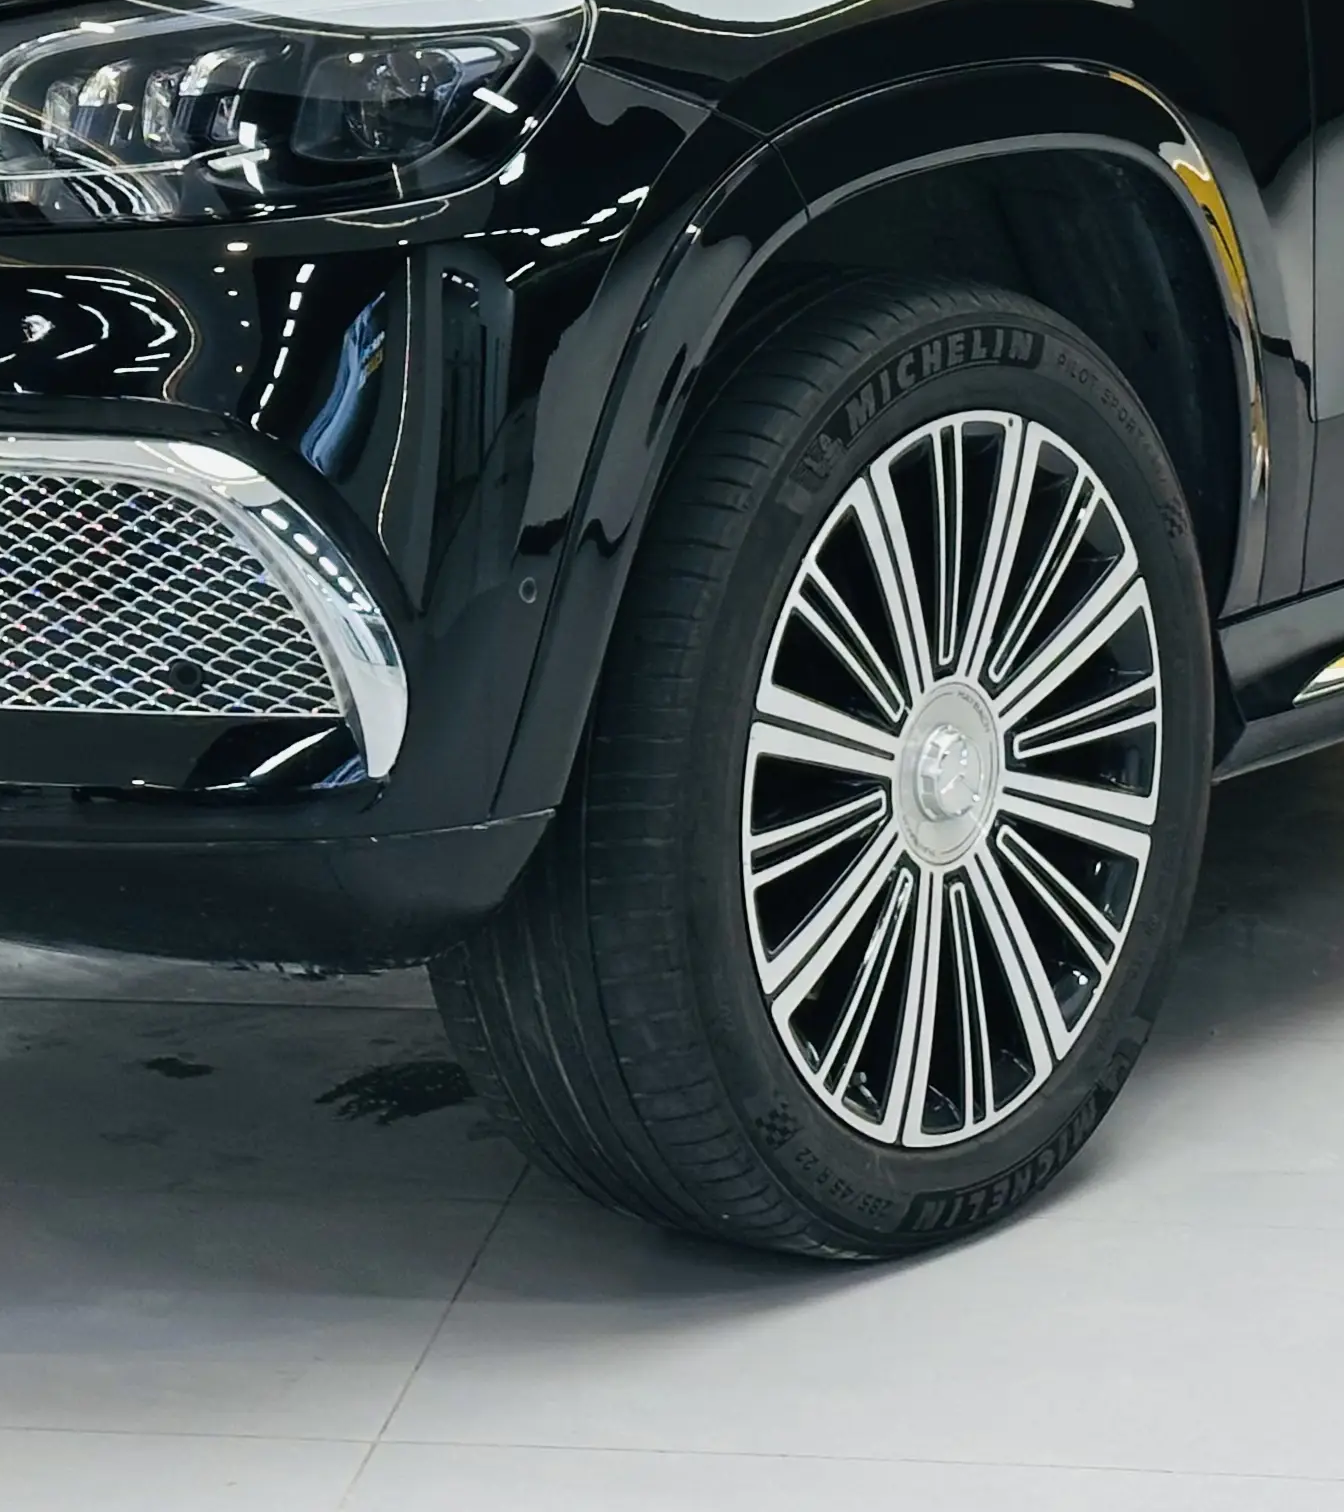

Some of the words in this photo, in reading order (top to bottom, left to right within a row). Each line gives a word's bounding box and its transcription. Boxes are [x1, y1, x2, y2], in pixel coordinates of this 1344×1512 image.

[845, 328, 1034, 436] MICHELIN
[1057, 353, 1099, 385] PILOT
[912, 1097, 1097, 1232] MICHELIN
